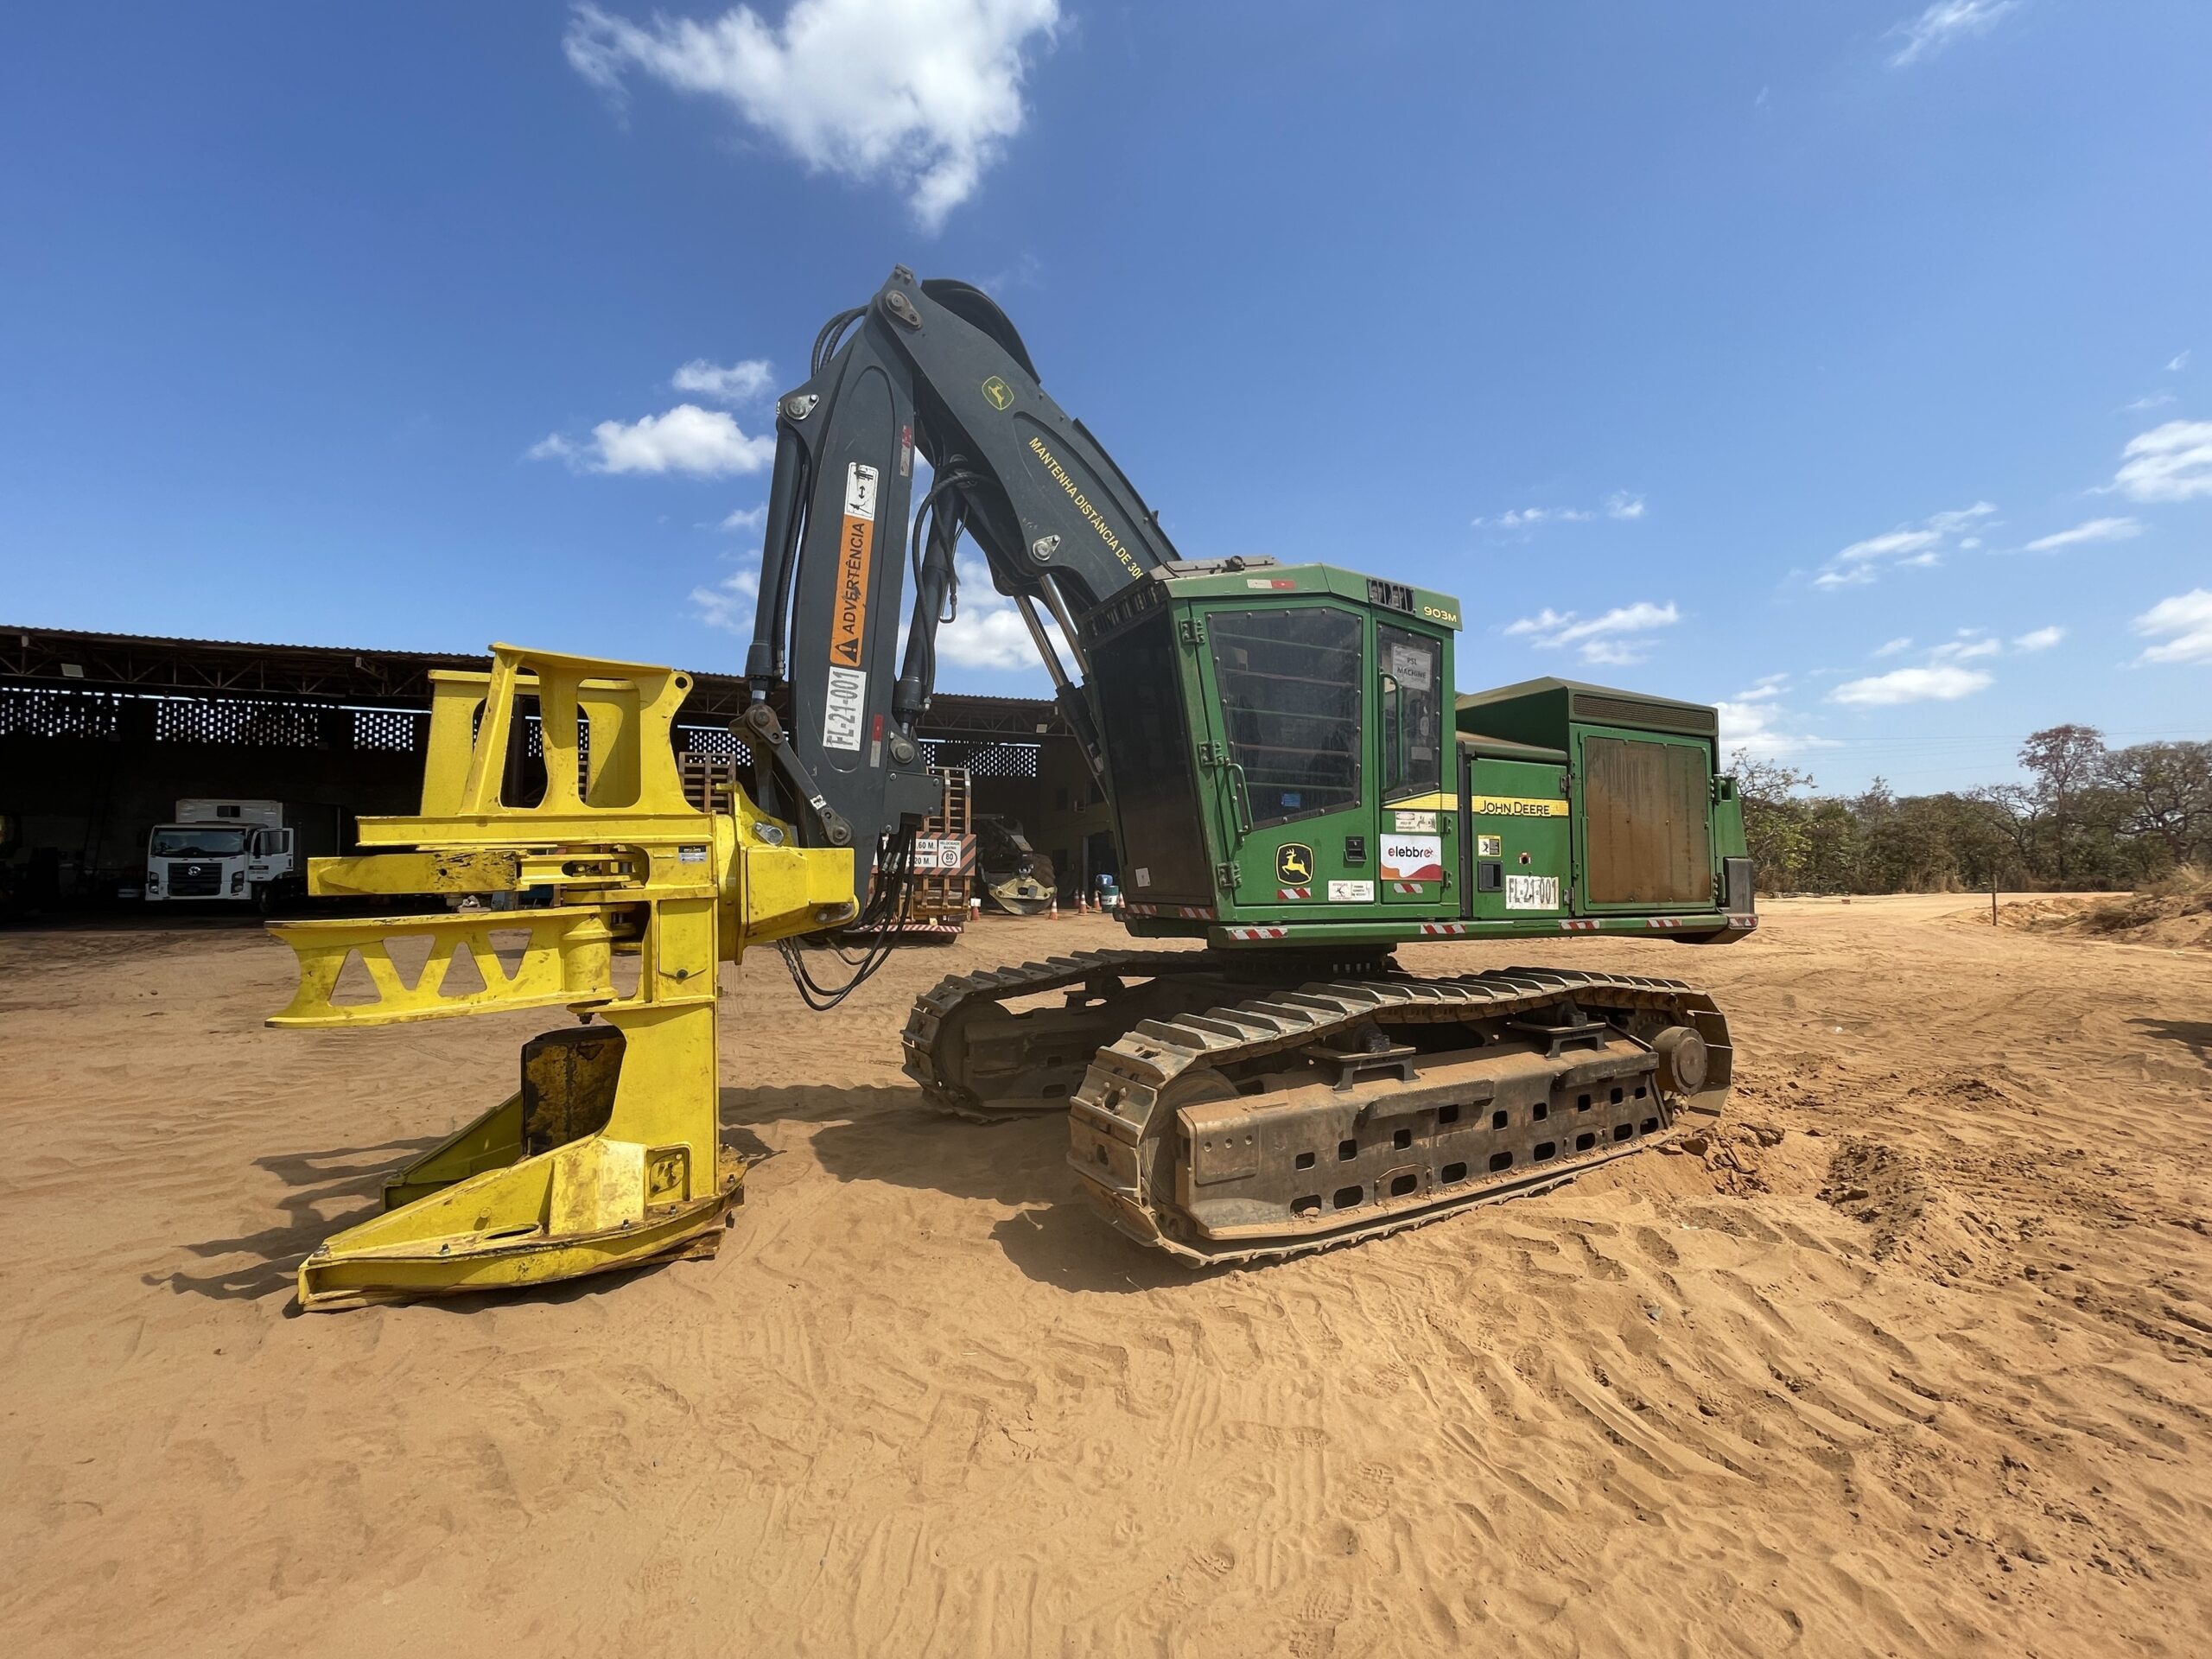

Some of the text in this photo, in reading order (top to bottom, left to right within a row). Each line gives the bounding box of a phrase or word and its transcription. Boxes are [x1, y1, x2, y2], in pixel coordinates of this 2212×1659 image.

[1029, 437, 1077, 498] MANTENHA
[1074, 494, 1119, 551] DISTÂNCIA
[1116, 547, 1132, 565] DE
[842, 522, 865, 634] ADVERTÊNCIA
[1424, 606, 1457, 622] 903M
[827, 671, 860, 746] FL-21-001
[1480, 800, 1550, 815] JOHN DEERE
